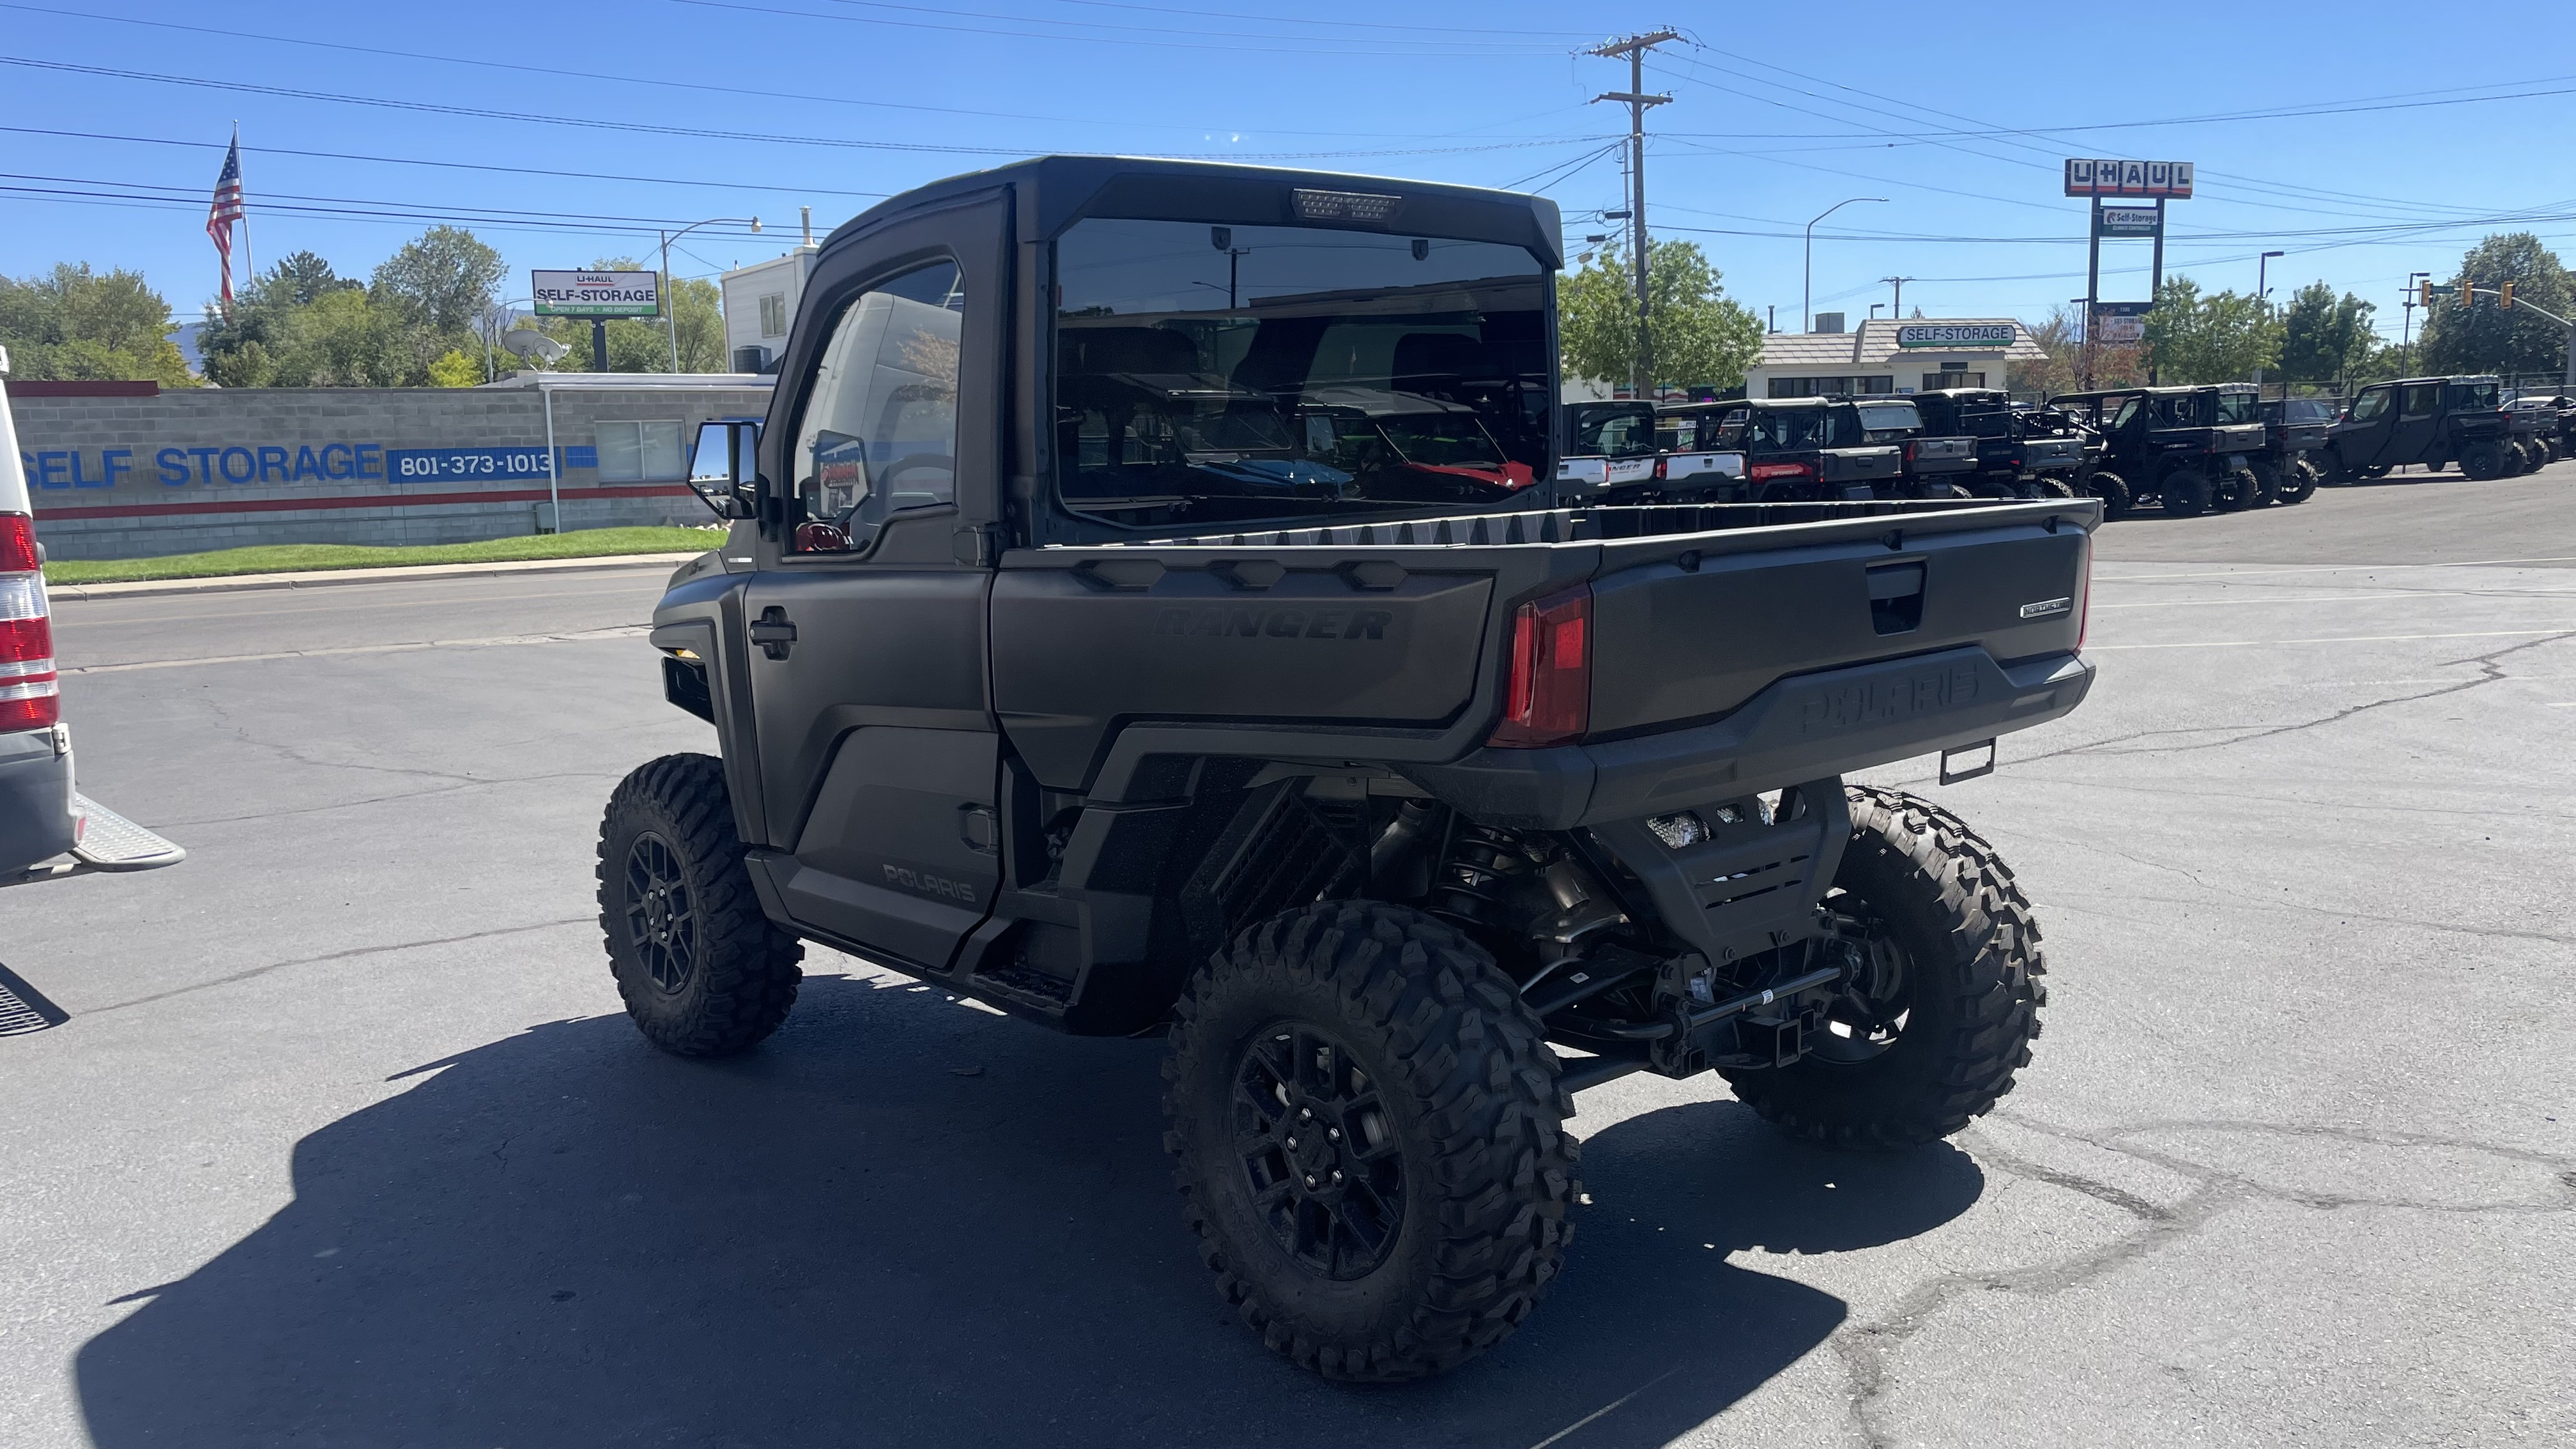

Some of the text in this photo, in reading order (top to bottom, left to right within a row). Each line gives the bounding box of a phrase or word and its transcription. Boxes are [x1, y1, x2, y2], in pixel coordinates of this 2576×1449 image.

[2117, 213, 2157, 224] Self-Storage
[537, 289, 655, 302] SELF-STORAGE
[1906, 327, 2009, 341] SELF-STORAGE
[157, 443, 383, 487] STORAGE
[401, 454, 551, 477] 801-373-1013
[1152, 606, 1393, 640] RANGER
[1800, 663, 1979, 733] POLARIS
[882, 863, 976, 903] POLARIS
